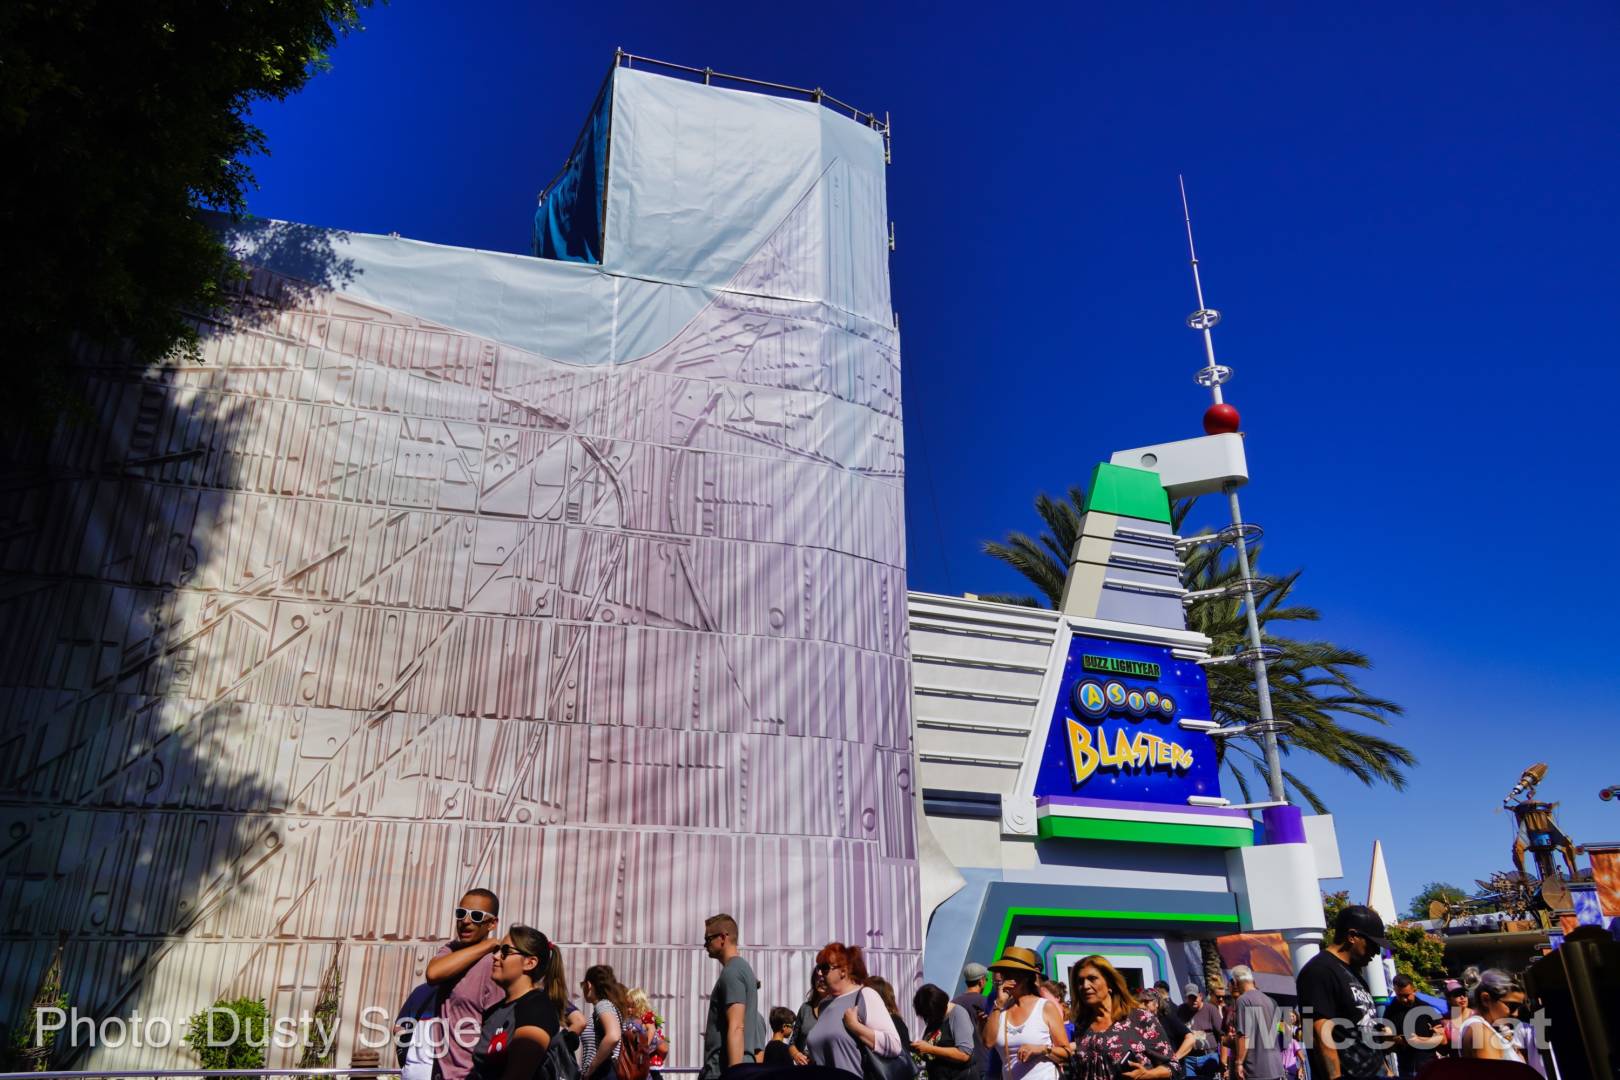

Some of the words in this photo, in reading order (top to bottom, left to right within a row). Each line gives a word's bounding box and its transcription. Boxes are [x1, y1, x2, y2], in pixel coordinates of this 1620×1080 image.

[1084, 655, 1109, 669] BUZZ
[1111, 658, 1160, 676] LIGHTYEAR
[1085, 684, 1172, 710] ASTRO
[1066, 717, 1194, 784] BLASTERS
